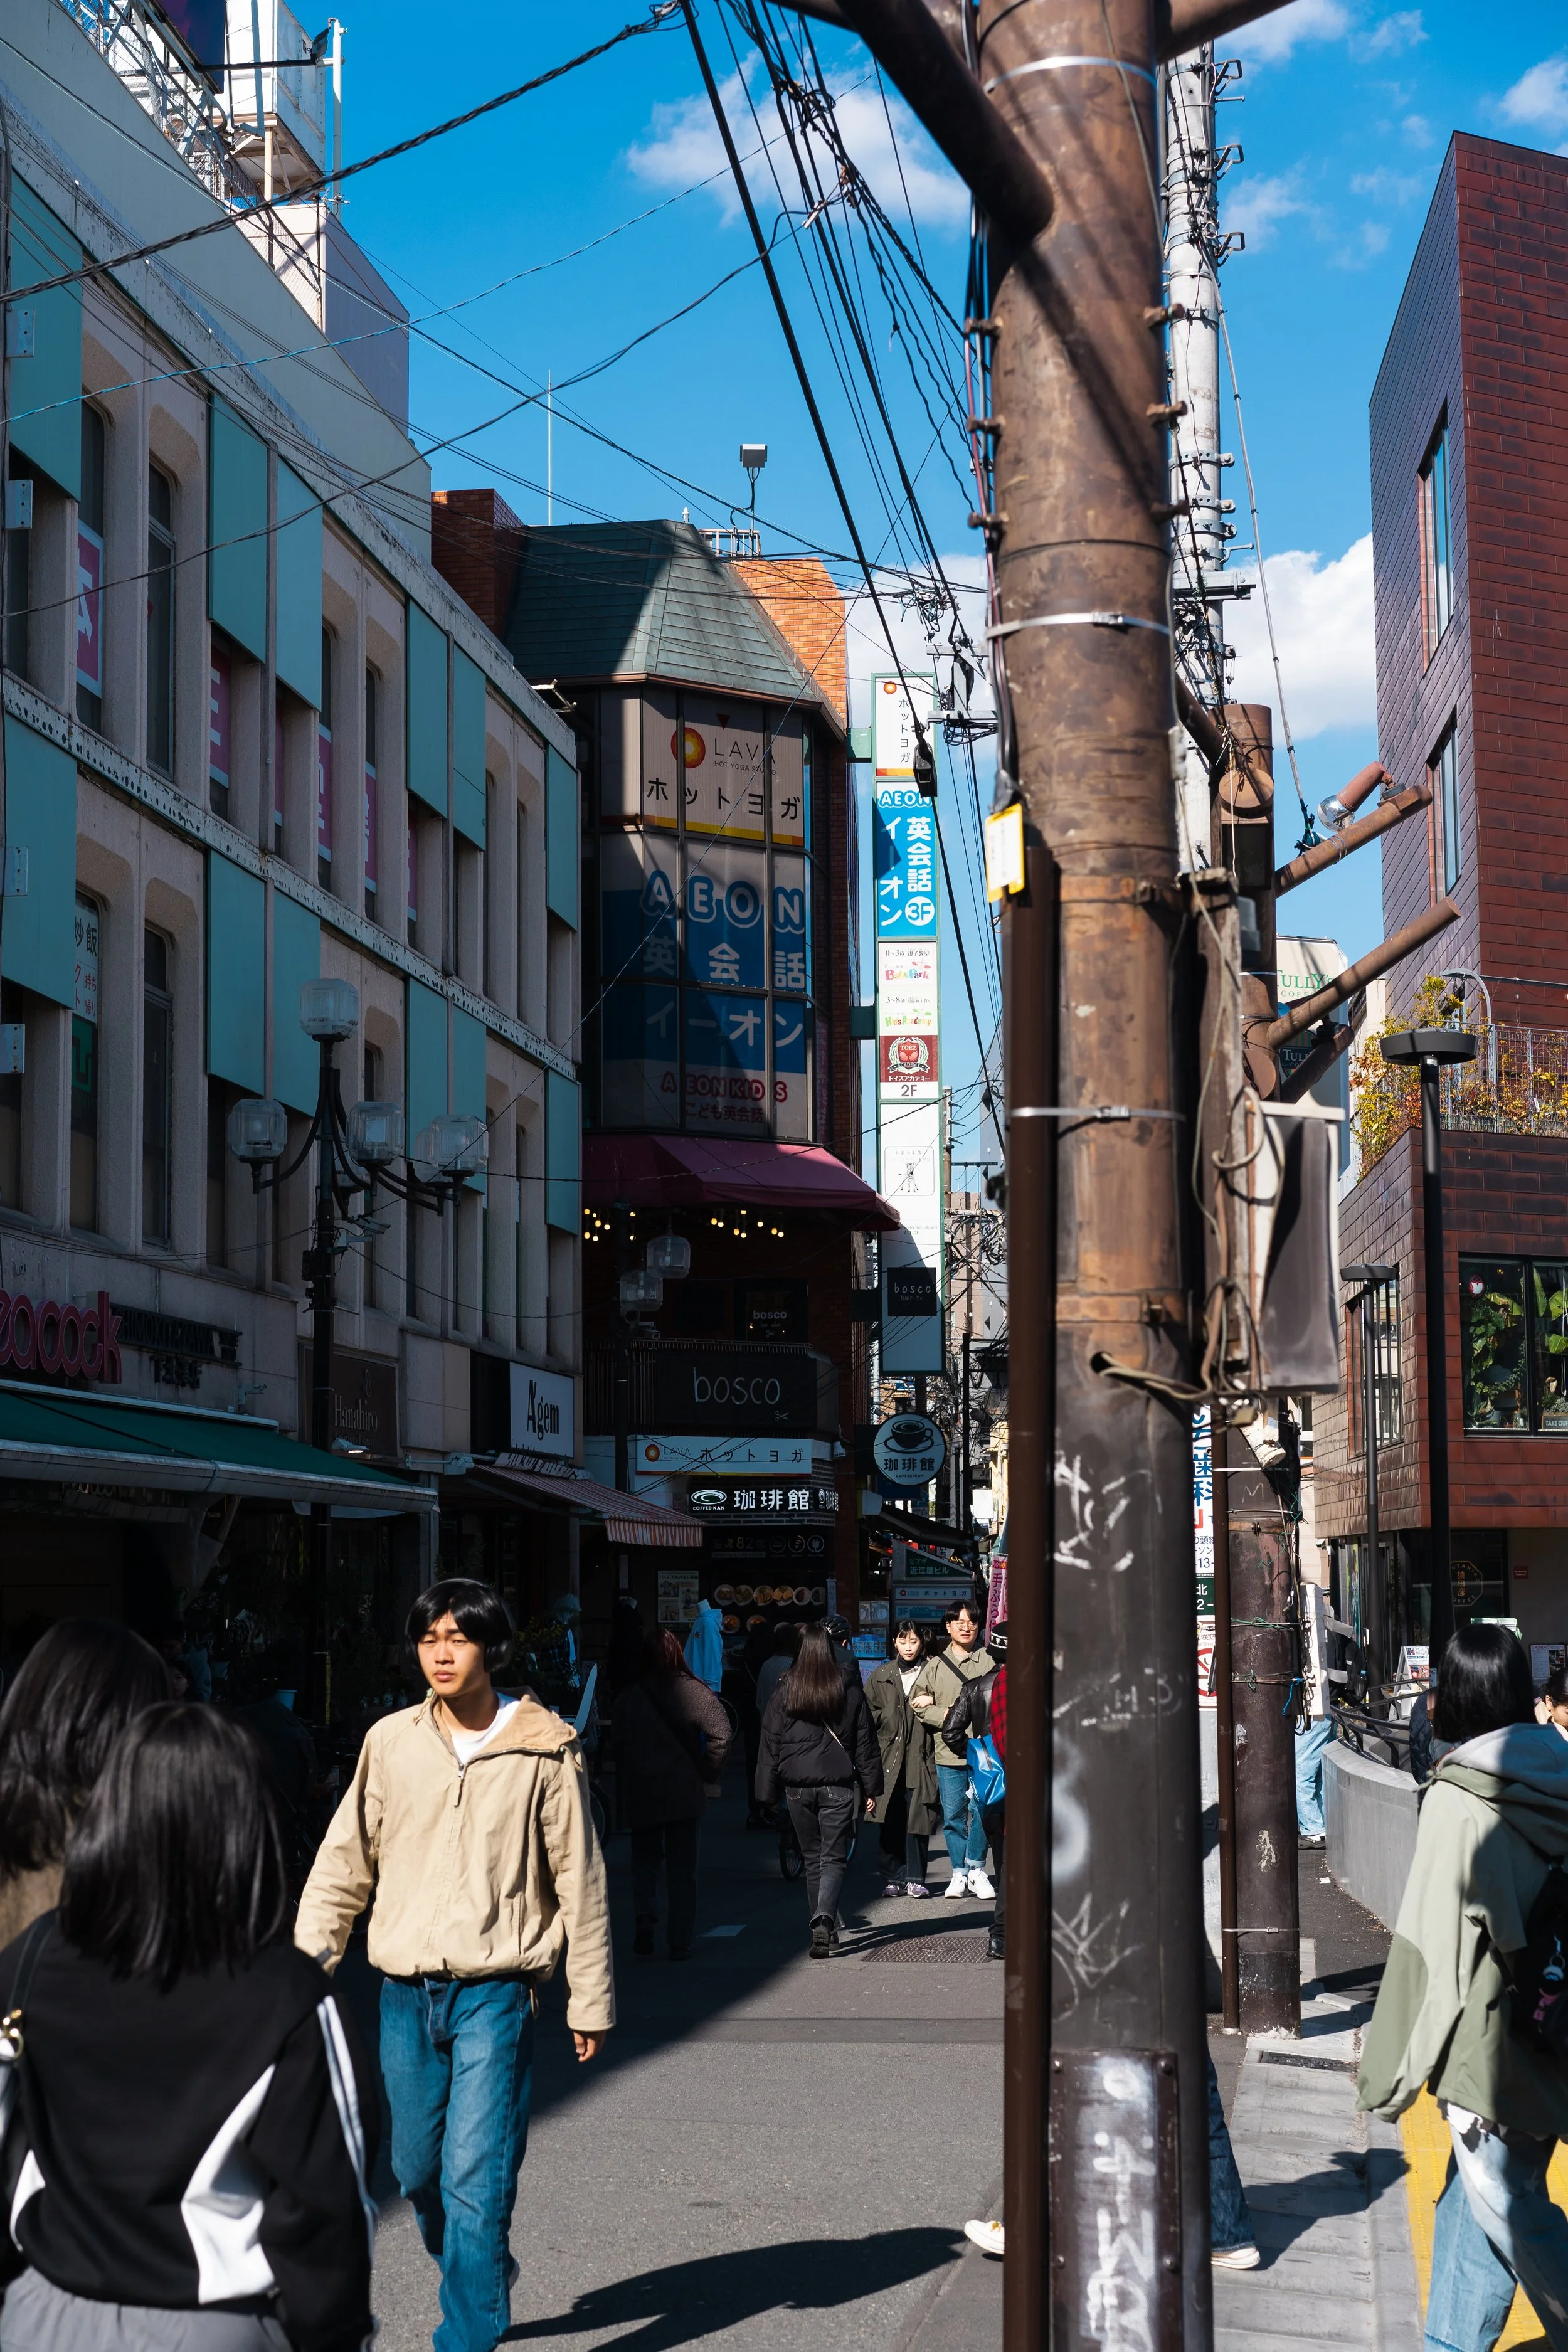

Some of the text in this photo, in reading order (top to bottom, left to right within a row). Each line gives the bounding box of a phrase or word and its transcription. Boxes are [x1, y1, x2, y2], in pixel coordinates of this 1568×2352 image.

[899, 699, 911, 763] ホットヨガ
[730, 763, 750, 771] YOGA
[751, 766, 776, 775] STUO
[647, 778, 801, 820] ホットヨガ
[879, 790, 933, 808] AEON
[907, 817, 932, 892] 英会話
[880, 817, 903, 926] イーオン
[643, 870, 805, 933] AEON
[908, 903, 931, 921] 3F
[644, 935, 805, 989] 英会話
[647, 1001, 803, 1047] イーオン
[660, 1071, 788, 1103] AEON KIDS
[901, 1084, 918, 1097] 2F
[686, 1103, 764, 1123] こども英会話
[894, 1283, 931, 1294] bosco
[753, 1310, 787, 1320] bosco
[0, 1290, 123, 1384] acock
[693, 1366, 781, 1405] bosco
[664, 1446, 691, 1456] LAVA
[701, 1448, 803, 1463] ホットヨガ
[884, 1458, 935, 1471] 珈琲館
[734, 1488, 810, 1510] 珈琲館
[1195, 1547, 1213, 1555] ソン
[910, 1566, 950, 1575] 近江屋ビル
[897, 1607, 908, 1616] 3F
